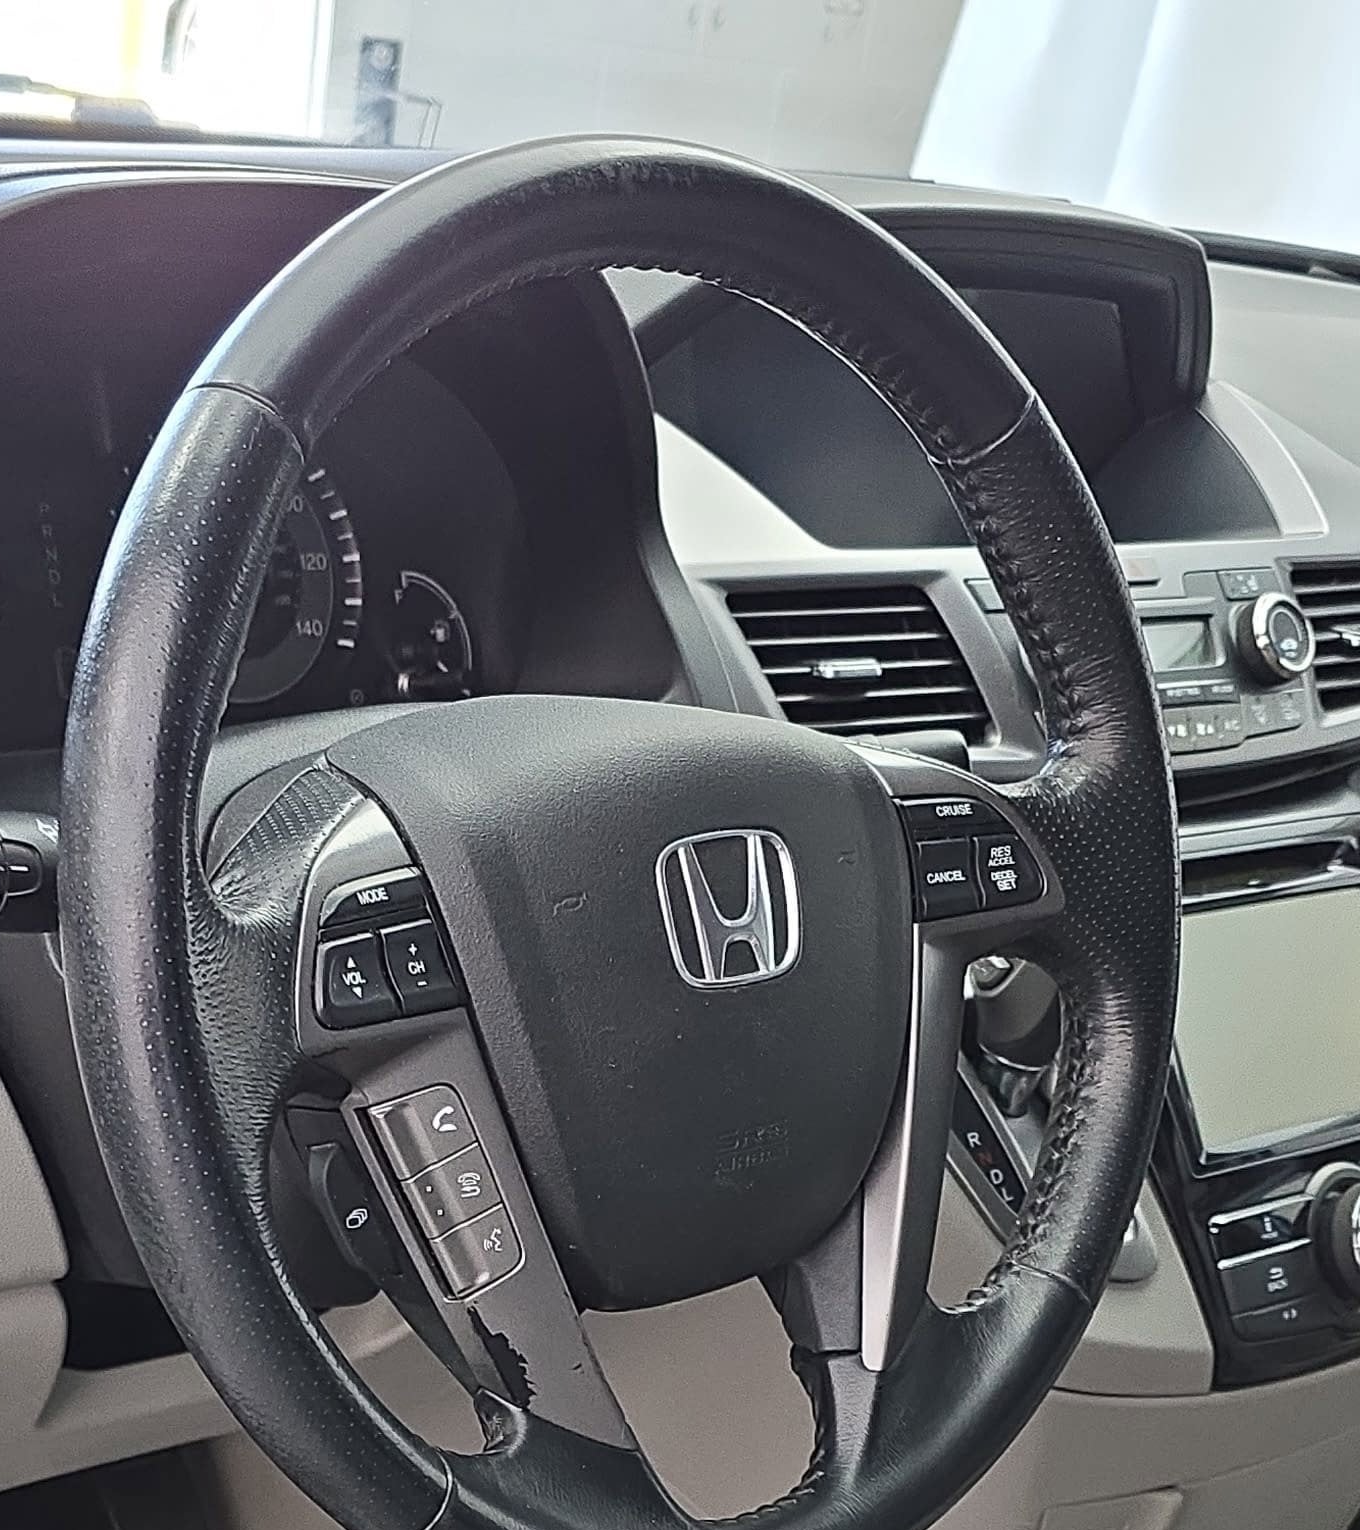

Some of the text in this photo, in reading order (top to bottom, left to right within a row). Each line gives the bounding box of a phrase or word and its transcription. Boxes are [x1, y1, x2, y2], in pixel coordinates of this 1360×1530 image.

[299, 554, 327, 571] 120
[296, 619, 323, 637] 140
[935, 803, 973, 817] CRUISE
[990, 845, 1011, 859] RES
[988, 855, 1016, 867] ACCEL
[926, 870, 967, 885] CANCEL
[990, 869, 1018, 882] DECEL
[996, 879, 1017, 891] SET
[357, 887, 389, 905] MODE
[407, 960, 426, 976] CH
[342, 971, 367, 986] VOL
[966, 1131, 982, 1148] R
[990, 1168, 1005, 1185] D
